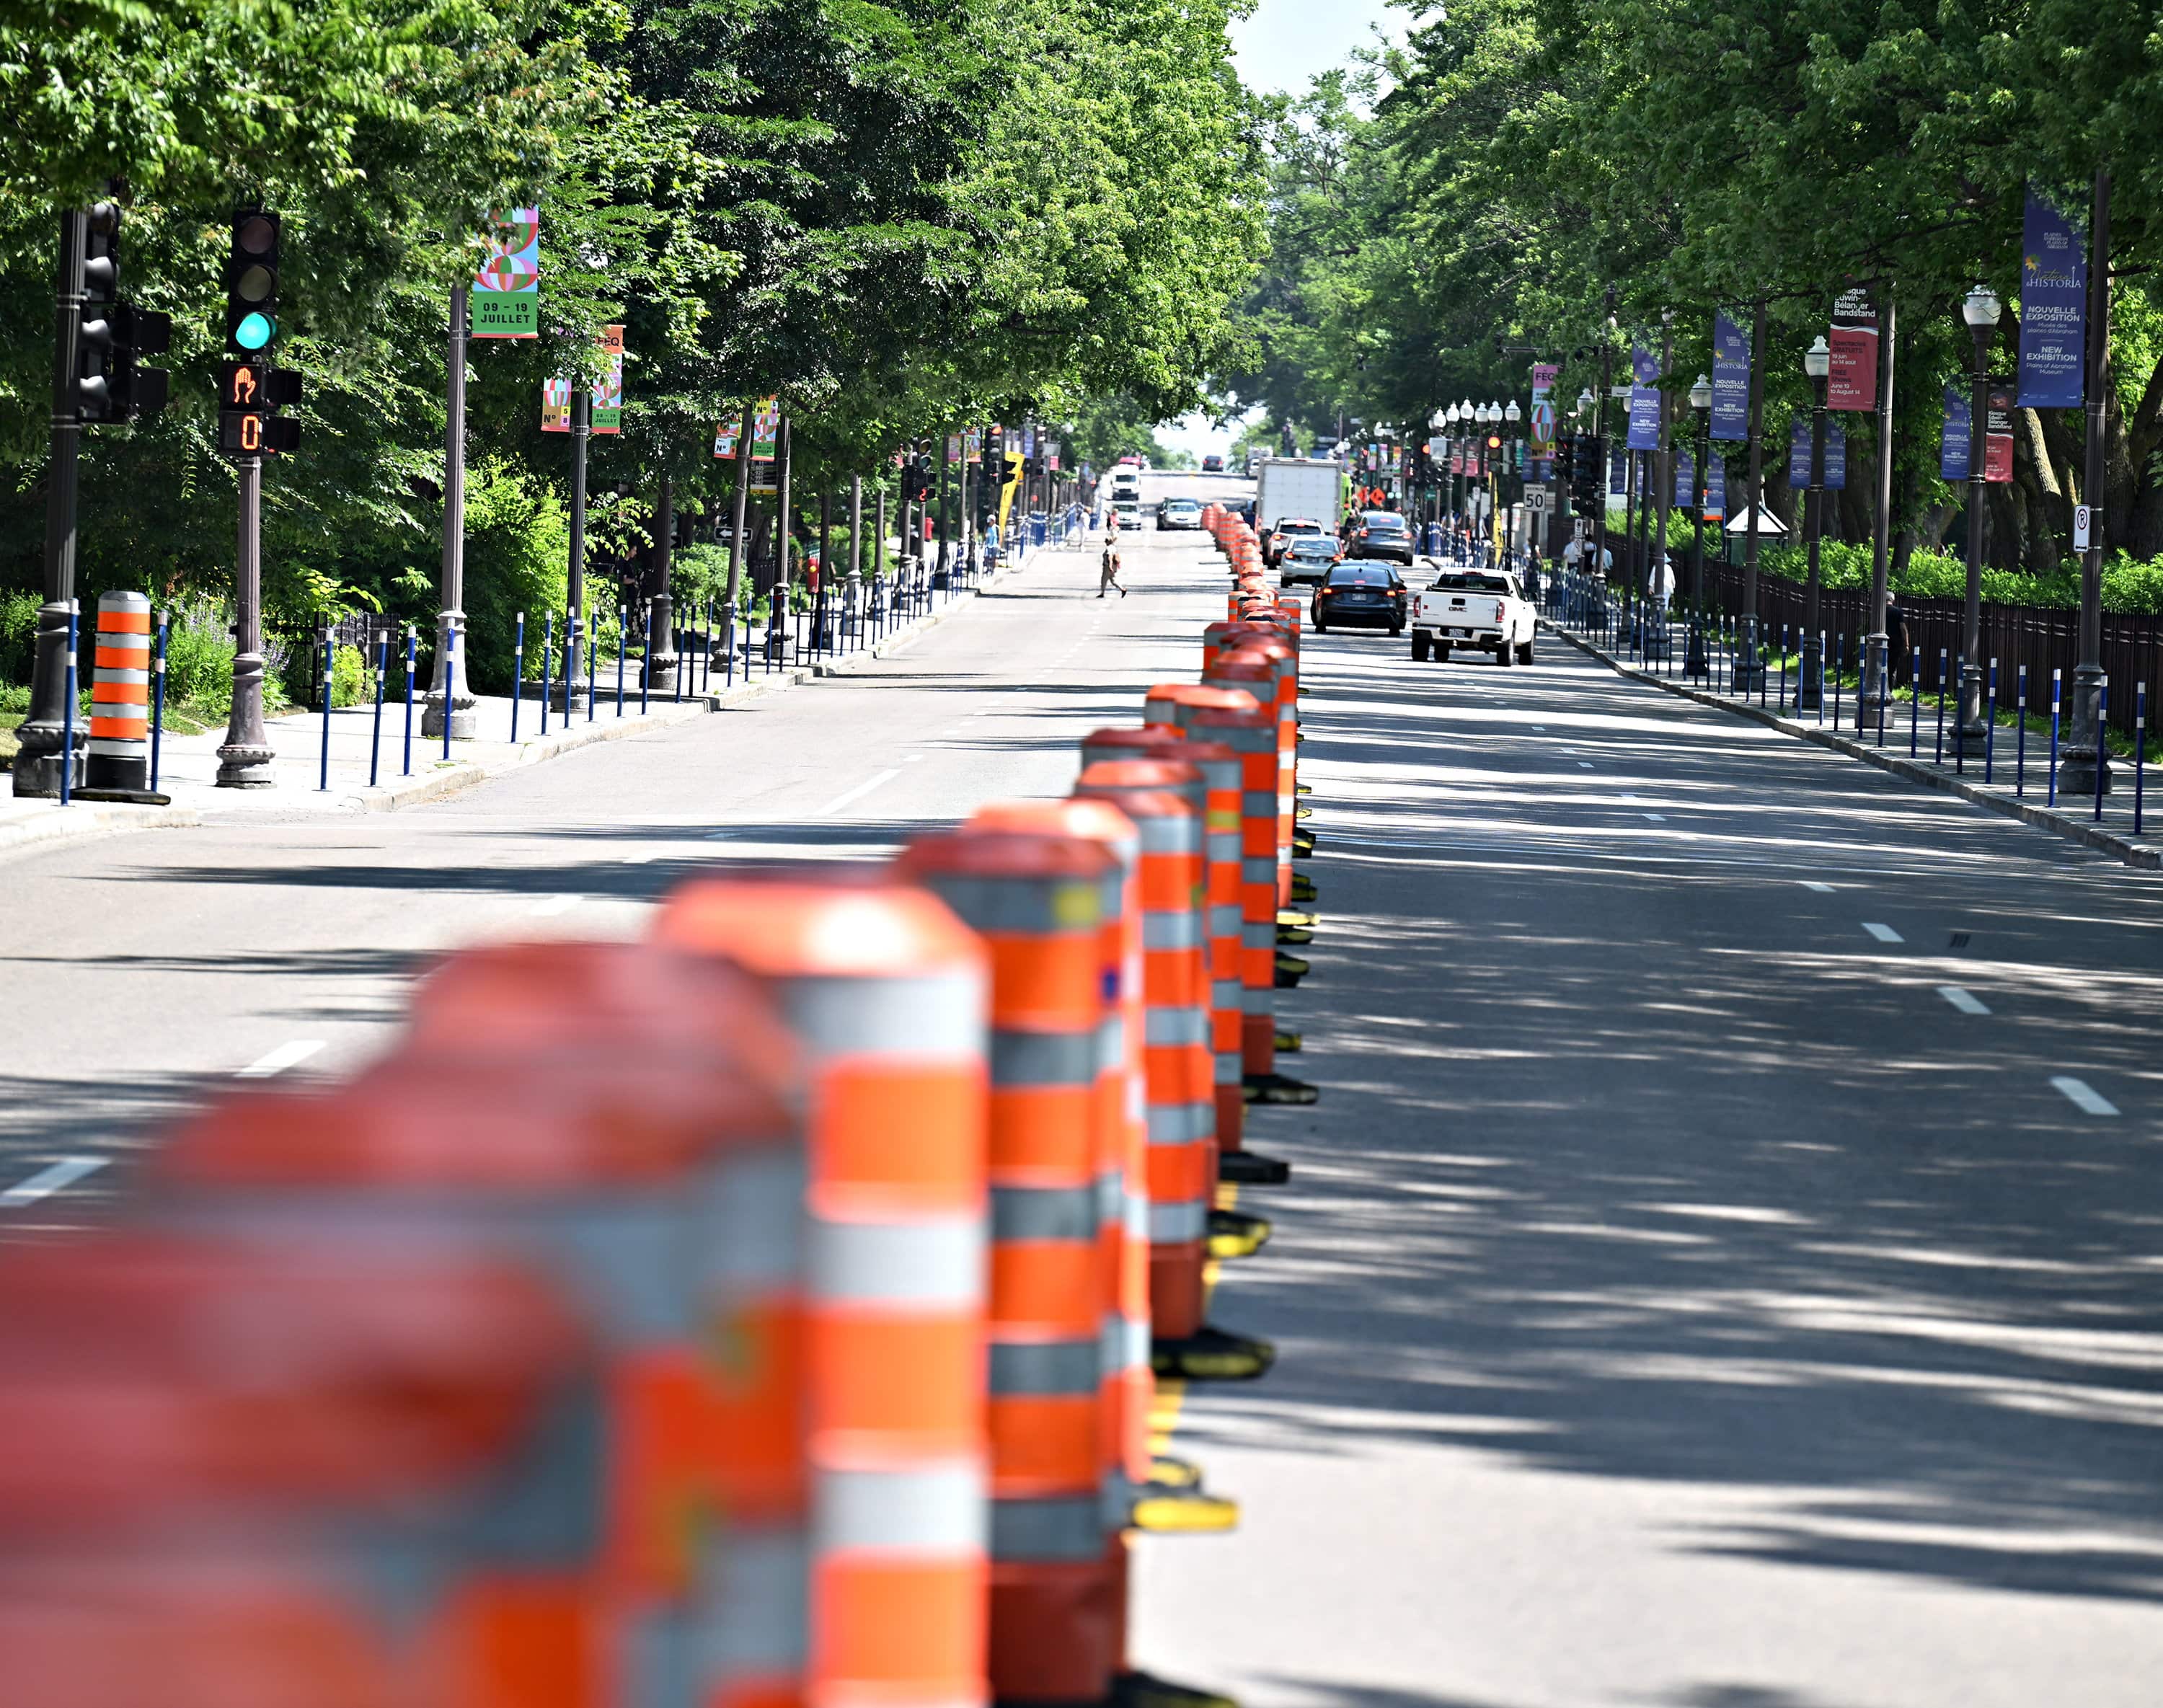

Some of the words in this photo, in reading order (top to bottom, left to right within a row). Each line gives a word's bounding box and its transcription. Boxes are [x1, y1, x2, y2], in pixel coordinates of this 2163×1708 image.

[483, 303, 498, 312] 09
[515, 303, 528, 312] 19
[2028, 306, 2076, 314] NOUVELLE
[1834, 309, 1875, 317] Bandstand
[2026, 313, 2080, 322] EXPOSITION
[480, 314, 531, 324] JUILLET
[2026, 353, 2076, 361] EXHIBITION
[242, 415, 259, 450] 0
[1526, 494, 1543, 508] 50
